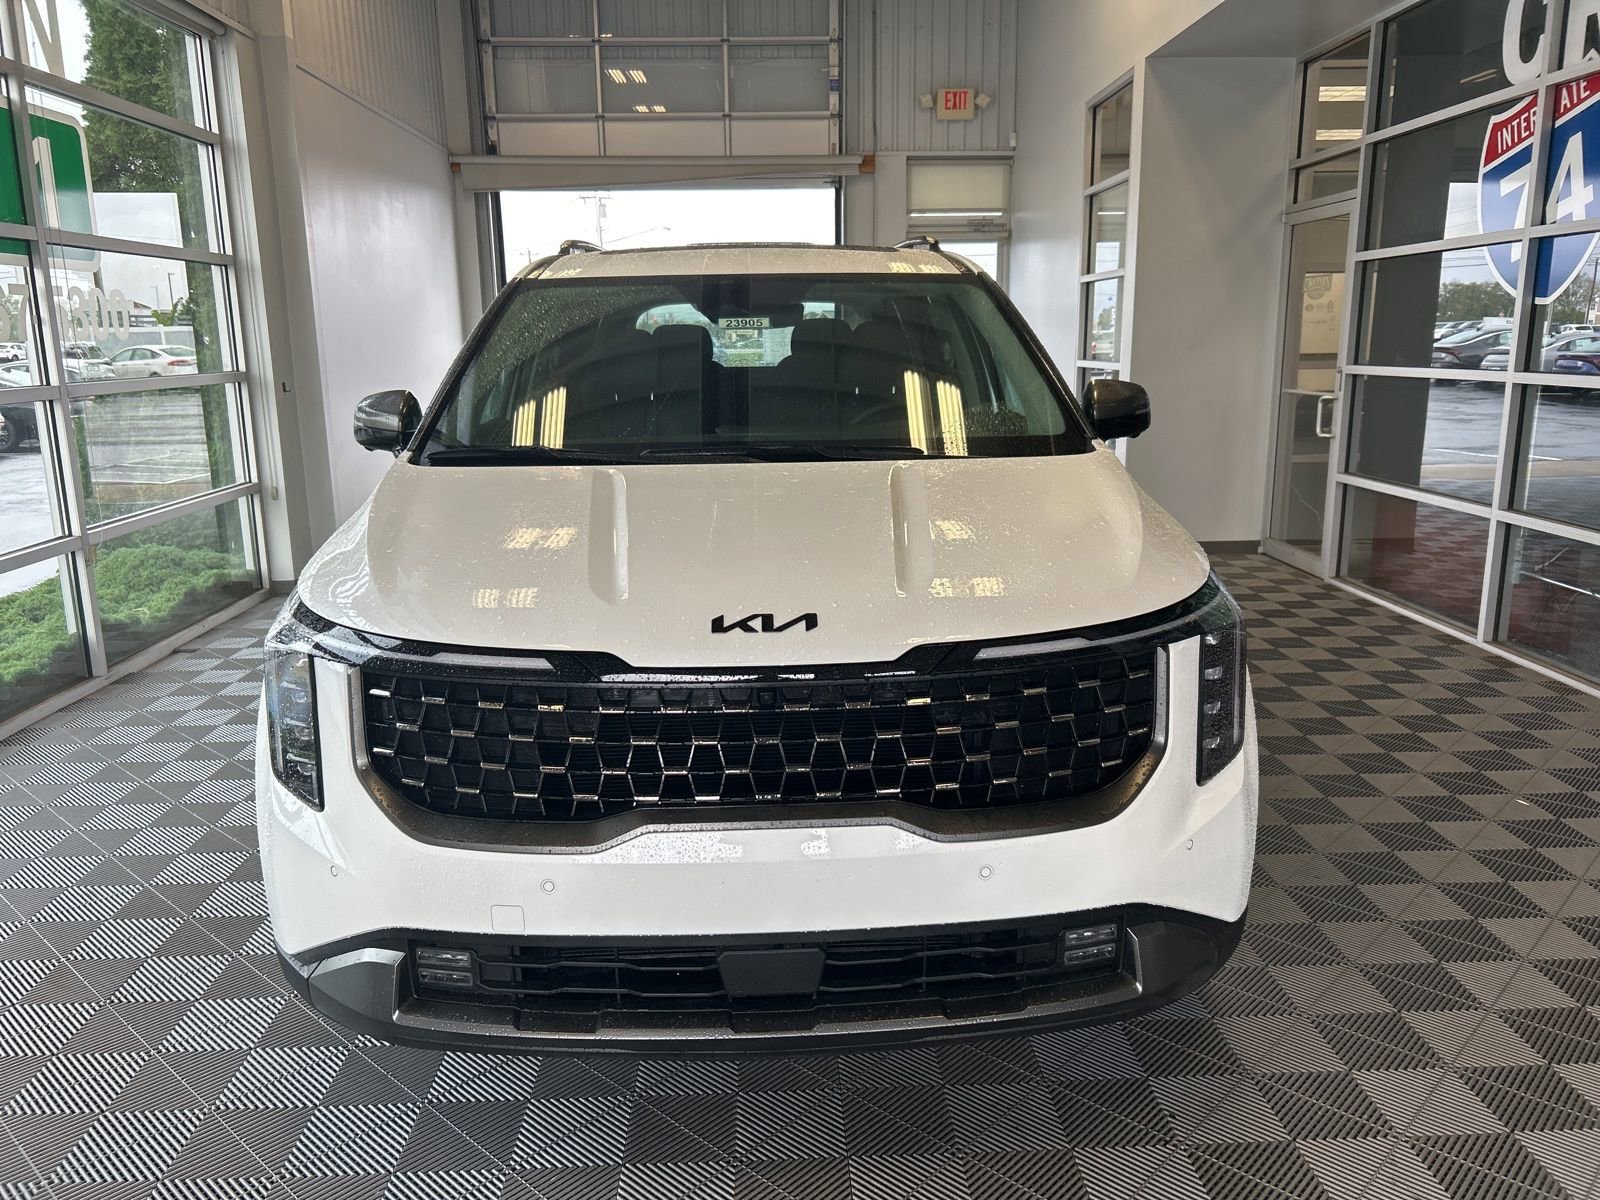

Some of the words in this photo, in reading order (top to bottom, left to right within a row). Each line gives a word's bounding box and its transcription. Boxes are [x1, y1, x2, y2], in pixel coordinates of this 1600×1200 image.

[944, 91, 969, 111] EXIT
[1500, 131, 1594, 263] 74
[725, 319, 764, 328] 23905
[711, 612, 819, 634] KIA
